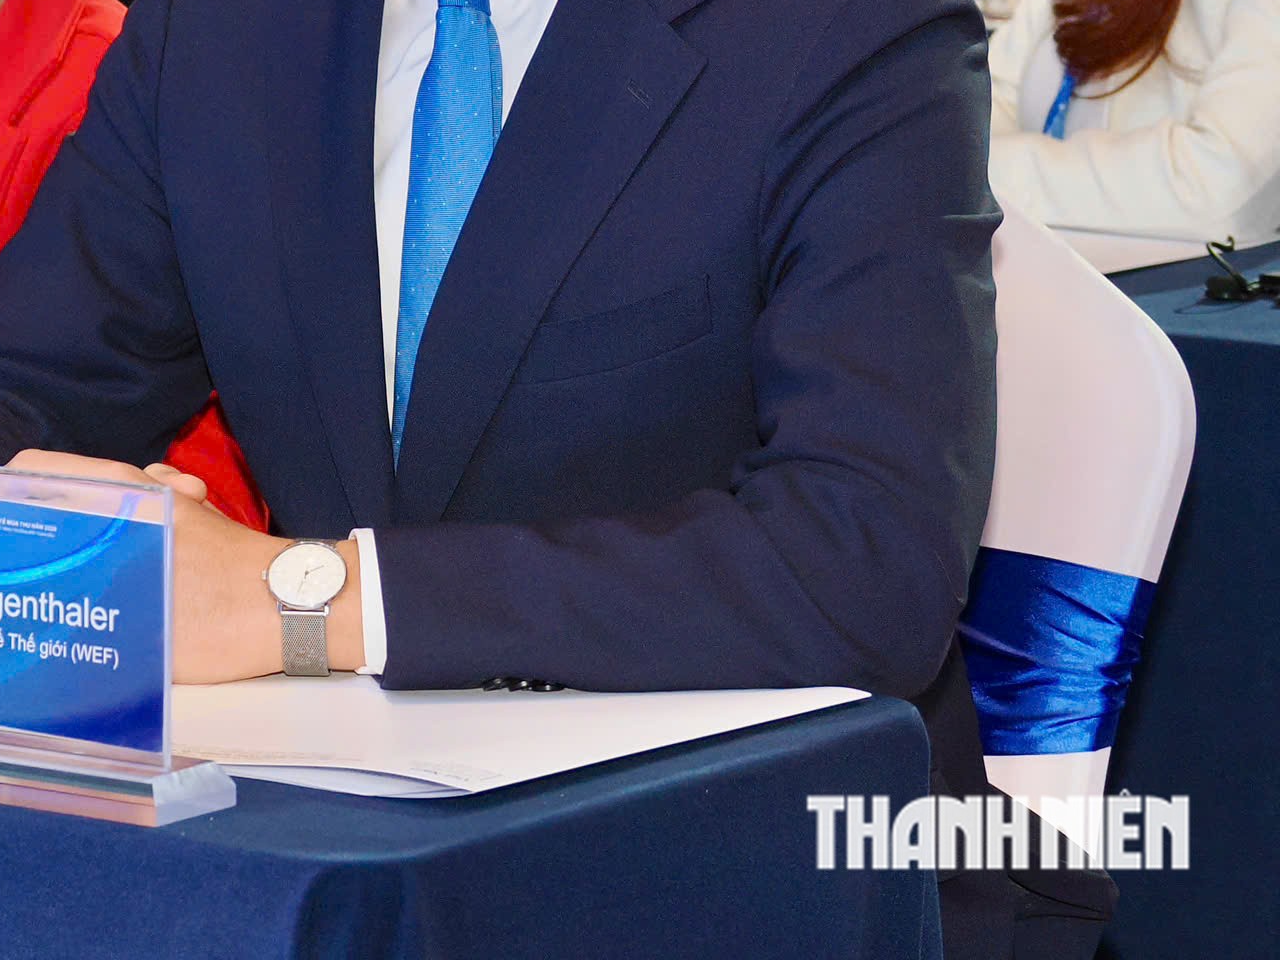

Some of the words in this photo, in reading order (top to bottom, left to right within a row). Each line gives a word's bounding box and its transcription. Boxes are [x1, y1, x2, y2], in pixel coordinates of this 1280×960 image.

[8, 632, 36, 653] Thế
[39, 640, 67, 659] giới
[71, 642, 120, 671] (WEF)
